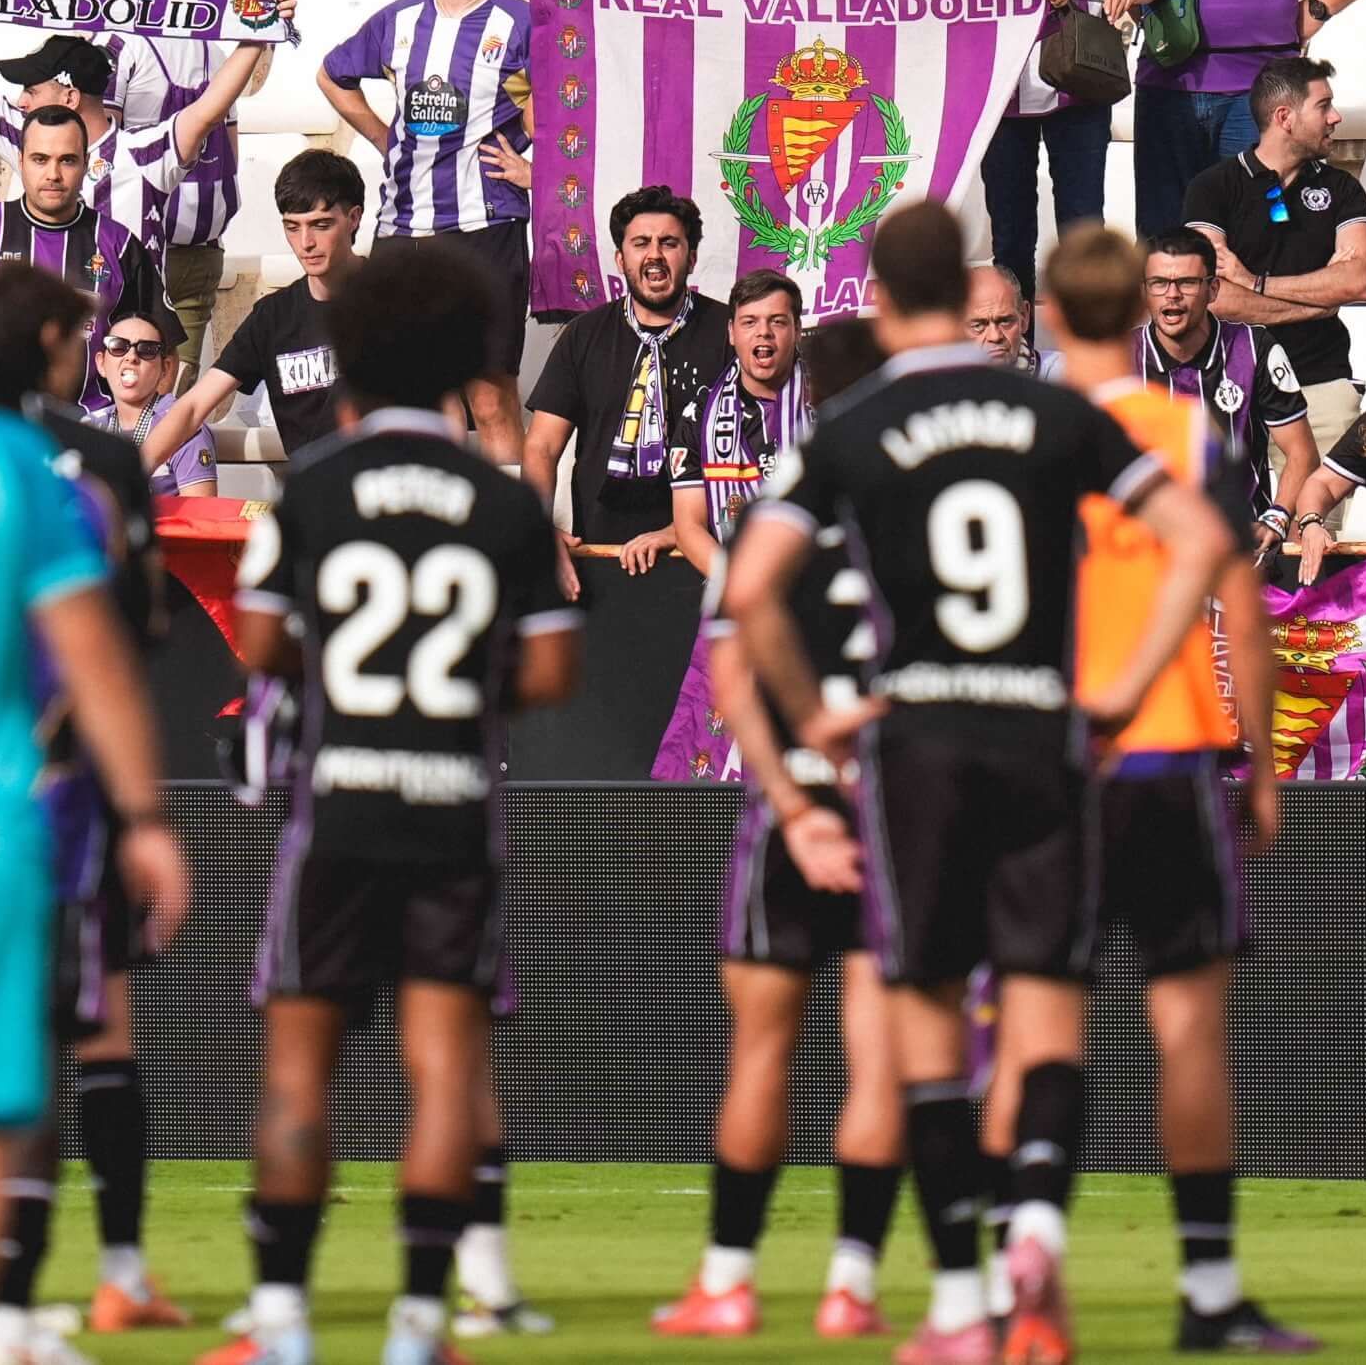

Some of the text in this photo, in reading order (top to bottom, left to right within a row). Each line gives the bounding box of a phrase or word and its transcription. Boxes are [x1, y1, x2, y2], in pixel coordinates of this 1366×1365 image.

[410, 91, 457, 108] Estrella
[410, 105, 453, 121] Galicia
[930, 479, 1029, 654] 9
[318, 541, 497, 718] 22
